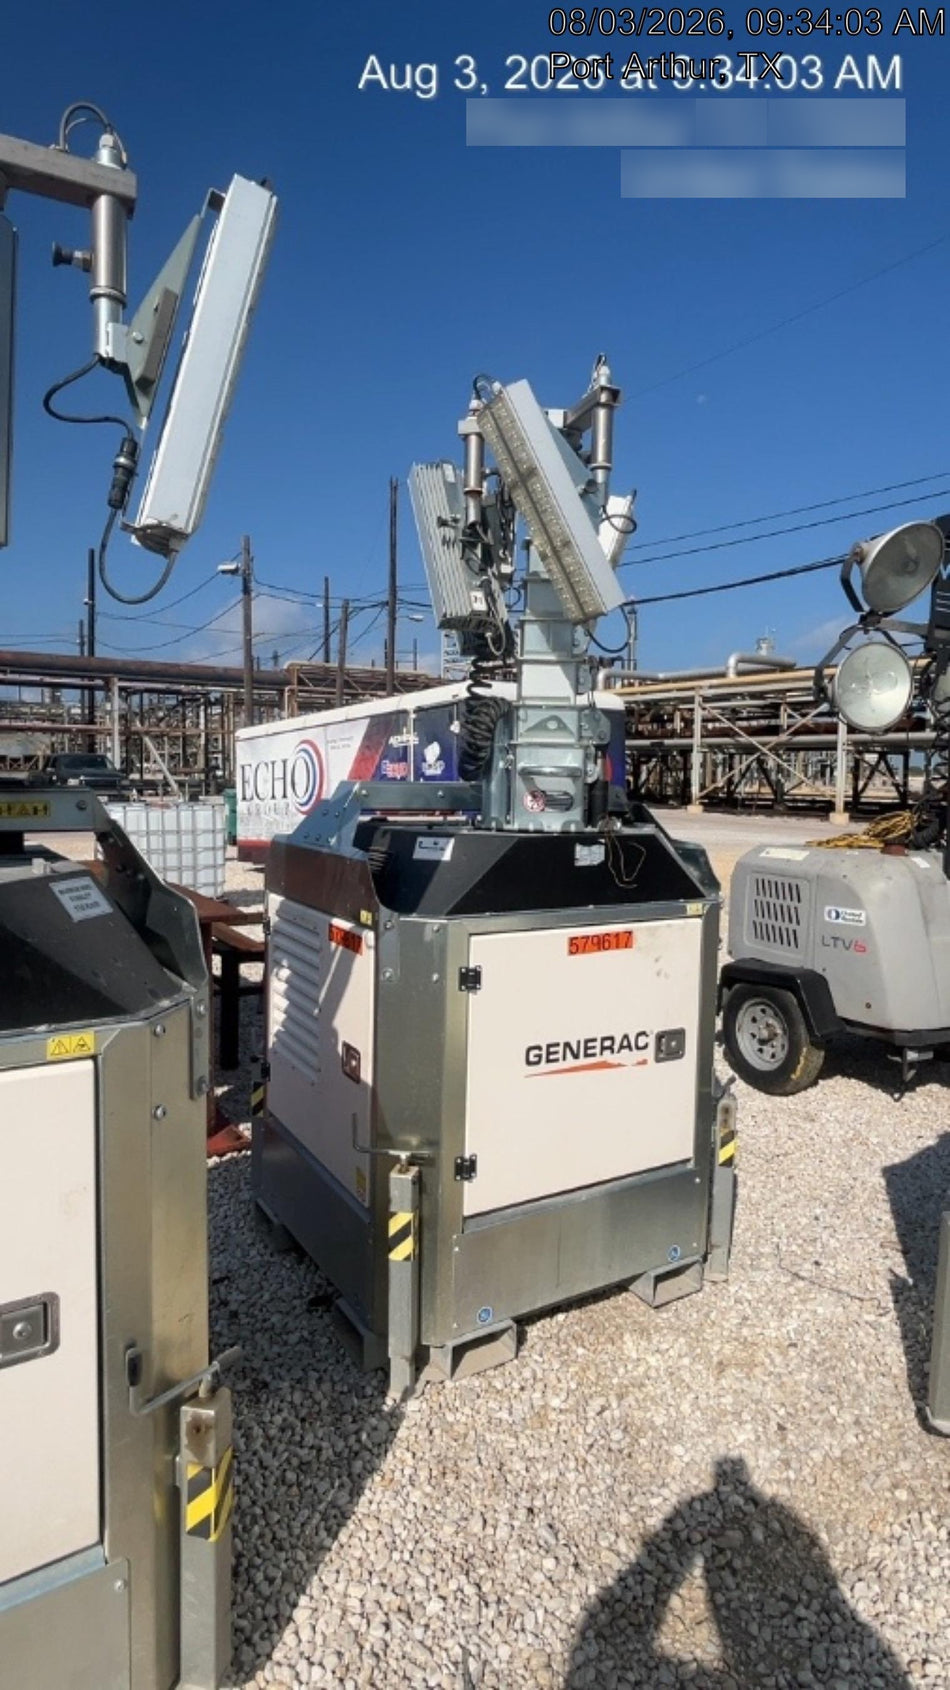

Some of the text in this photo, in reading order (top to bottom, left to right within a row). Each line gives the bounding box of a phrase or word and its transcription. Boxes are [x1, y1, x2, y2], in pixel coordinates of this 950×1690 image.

[240, 756, 311, 802] ECHO
[569, 931, 633, 956] 579617
[821, 934, 867, 953] LTV6
[524, 1030, 650, 1067] GENERAC
